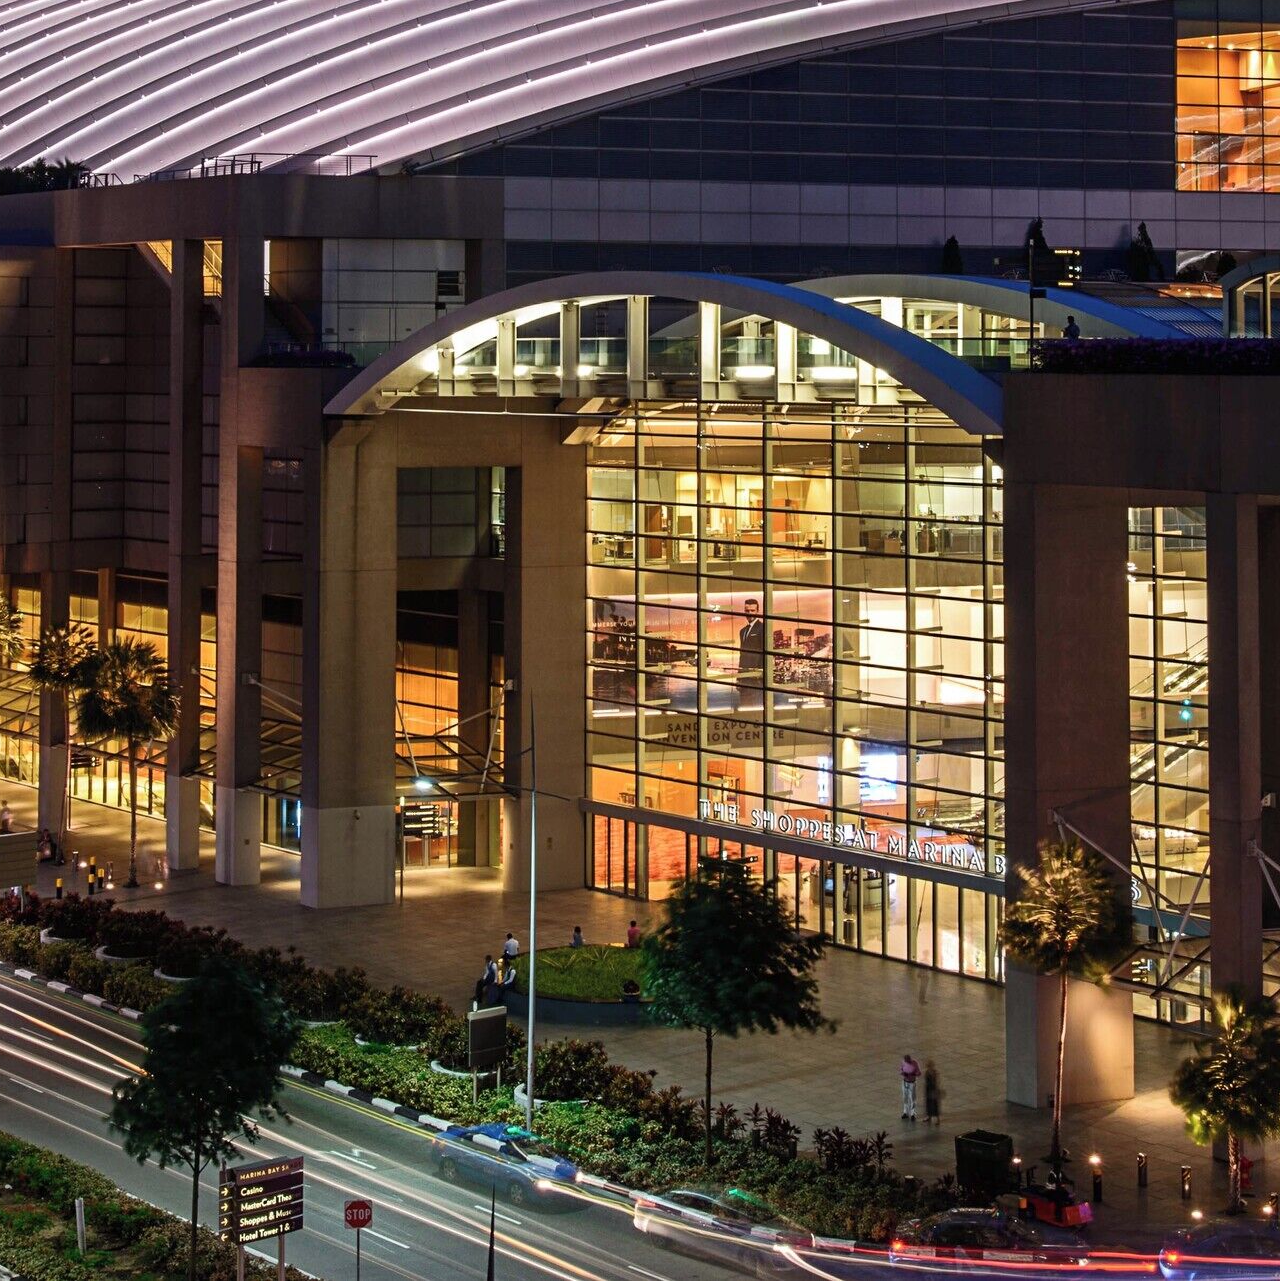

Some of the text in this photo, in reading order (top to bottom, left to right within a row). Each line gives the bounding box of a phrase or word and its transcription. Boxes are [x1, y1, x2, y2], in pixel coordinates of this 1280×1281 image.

[714, 720, 747, 731] EXPO
[699, 799, 739, 825] THE
[750, 808, 846, 844] SHOPPES
[852, 828, 881, 850] AT
[887, 835, 985, 871] MARINA
[240, 1170, 267, 1180] MARINA
[267, 1166, 280, 1175] BAY
[240, 1186, 264, 1197] Casino
[240, 1196, 277, 1211] MasterCard
[240, 1215, 268, 1227] Shoppes
[269, 1211, 276, 1221] &
[346, 1209, 371, 1220] STOP
[239, 1231, 259, 1242] Hotel
[259, 1228, 279, 1238] Tower
[284, 1222, 291, 1231] &
